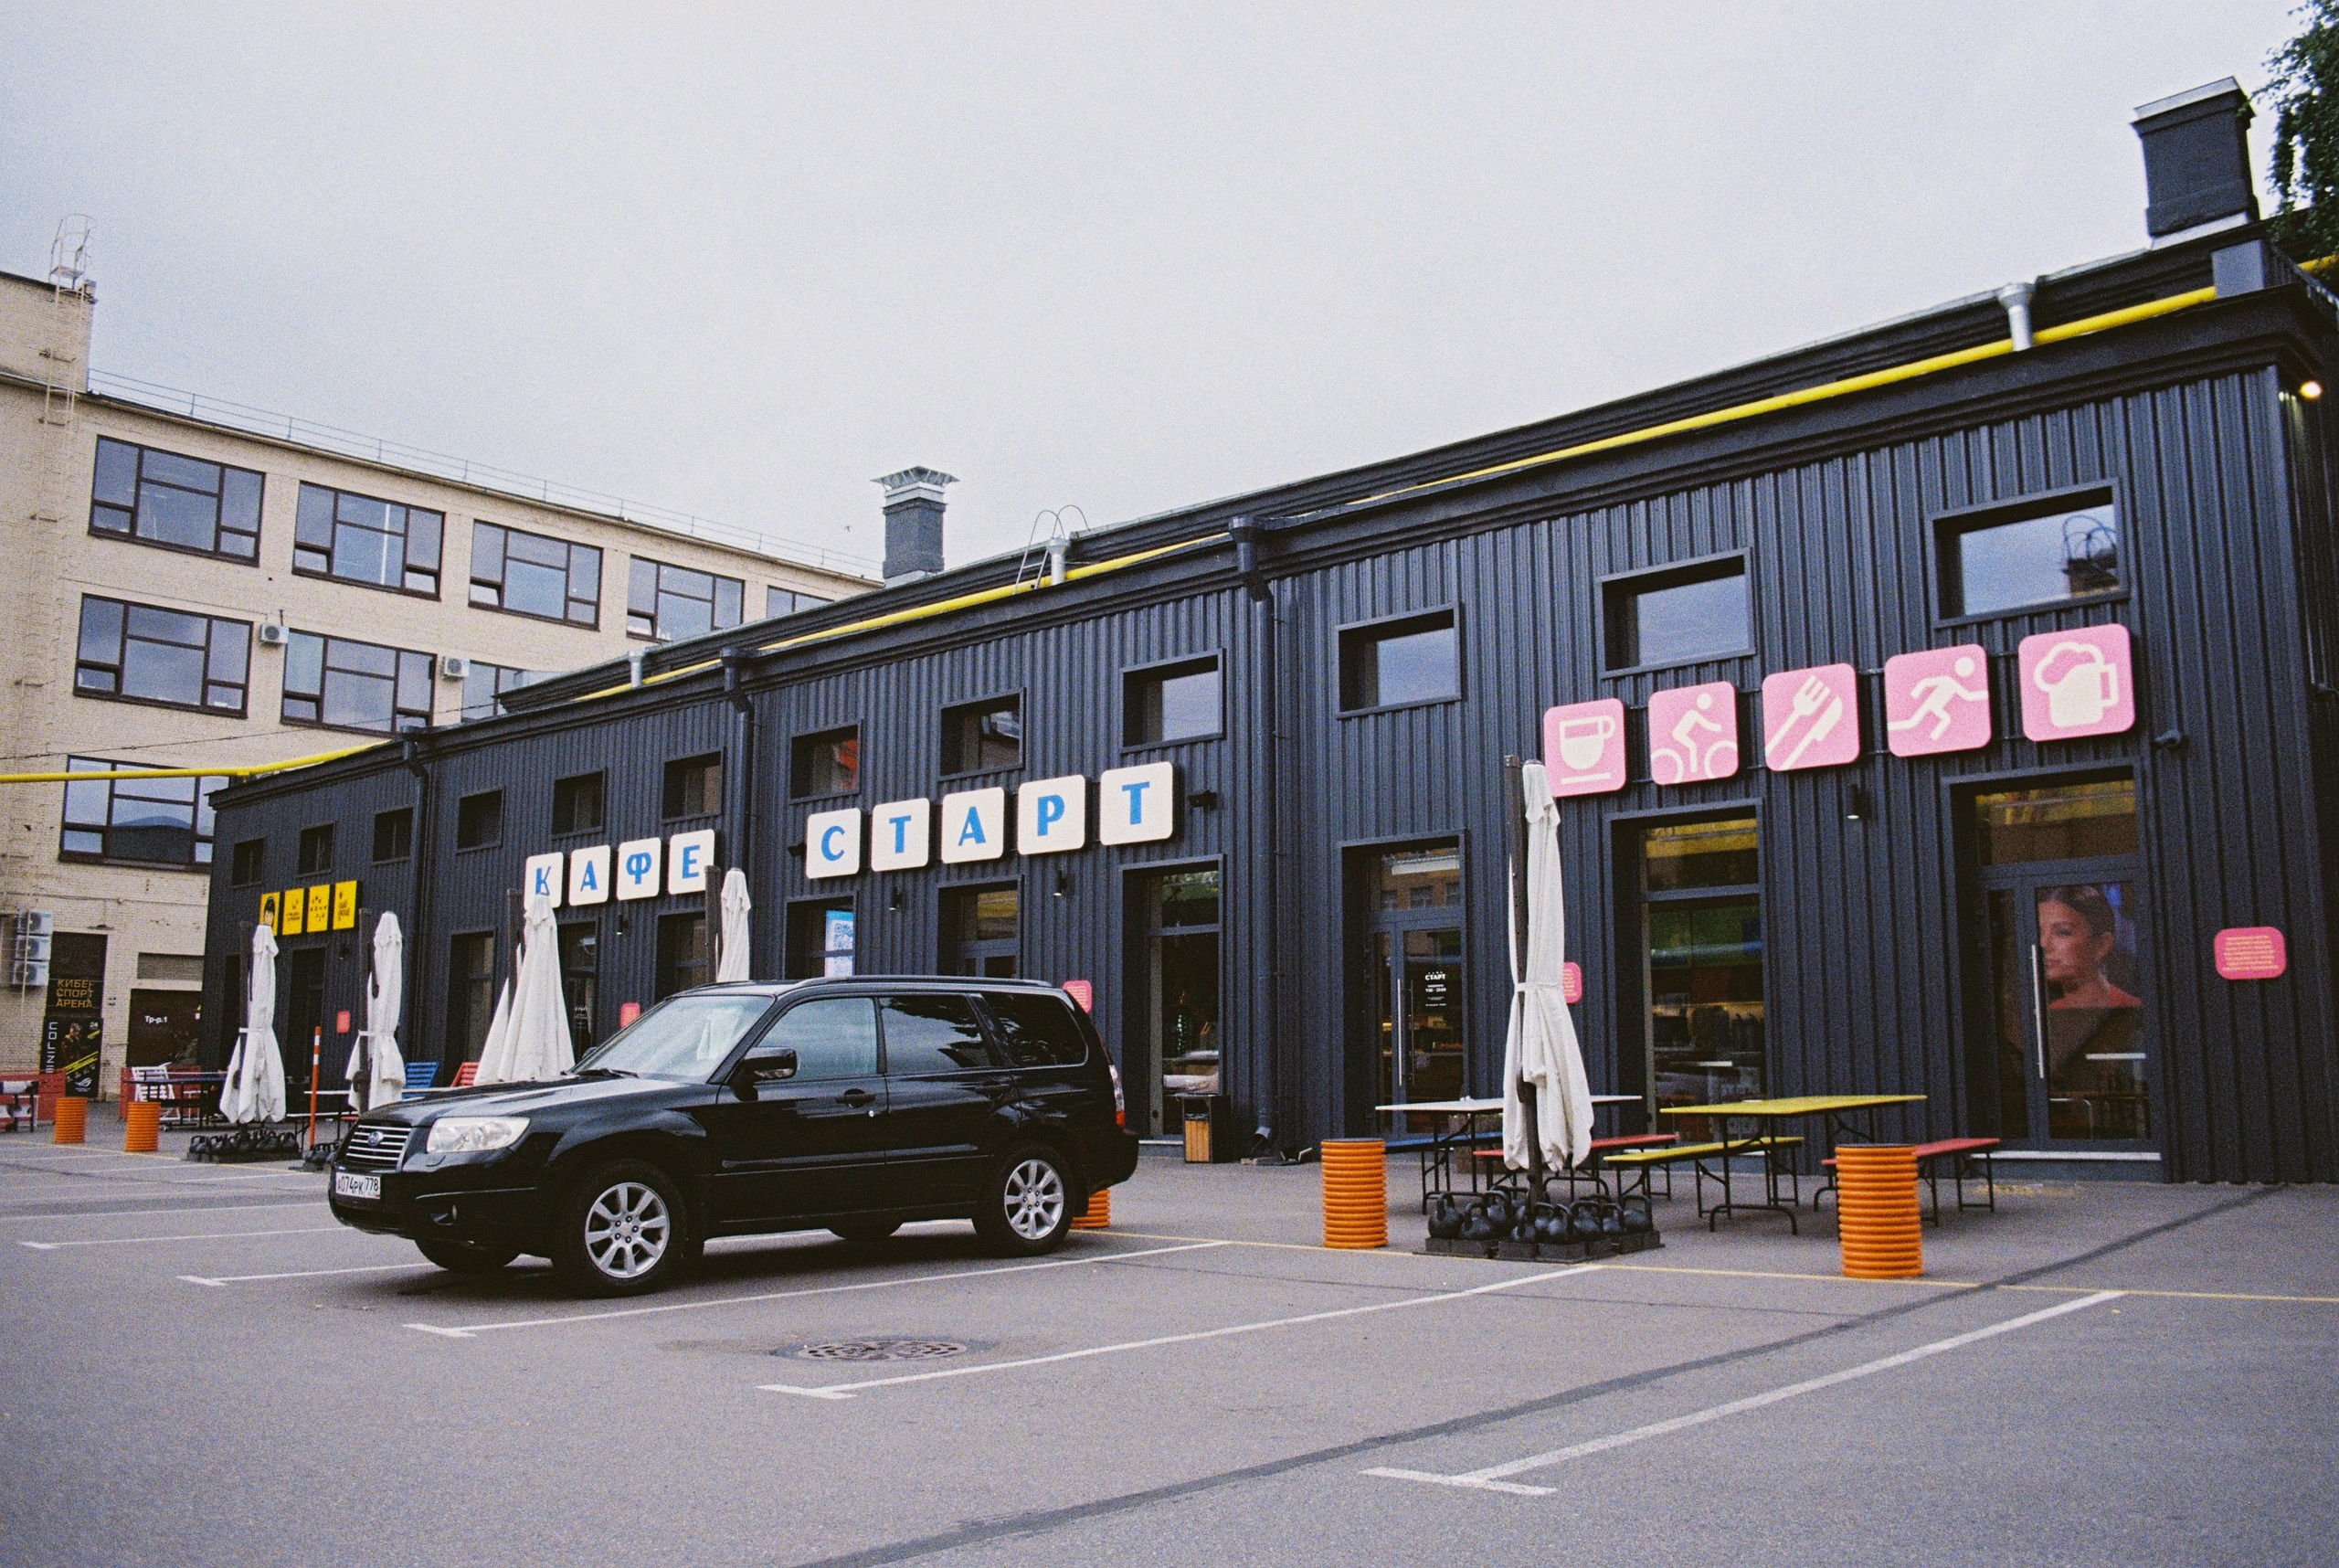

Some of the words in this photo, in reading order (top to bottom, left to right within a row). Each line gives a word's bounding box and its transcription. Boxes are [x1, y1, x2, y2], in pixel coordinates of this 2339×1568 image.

[534, 844, 701, 895] КАФЕ
[821, 781, 1150, 862] СТАРТ
[56, 988, 94, 998] СПОРТ
[56, 998, 93, 1009] АРЕНА
